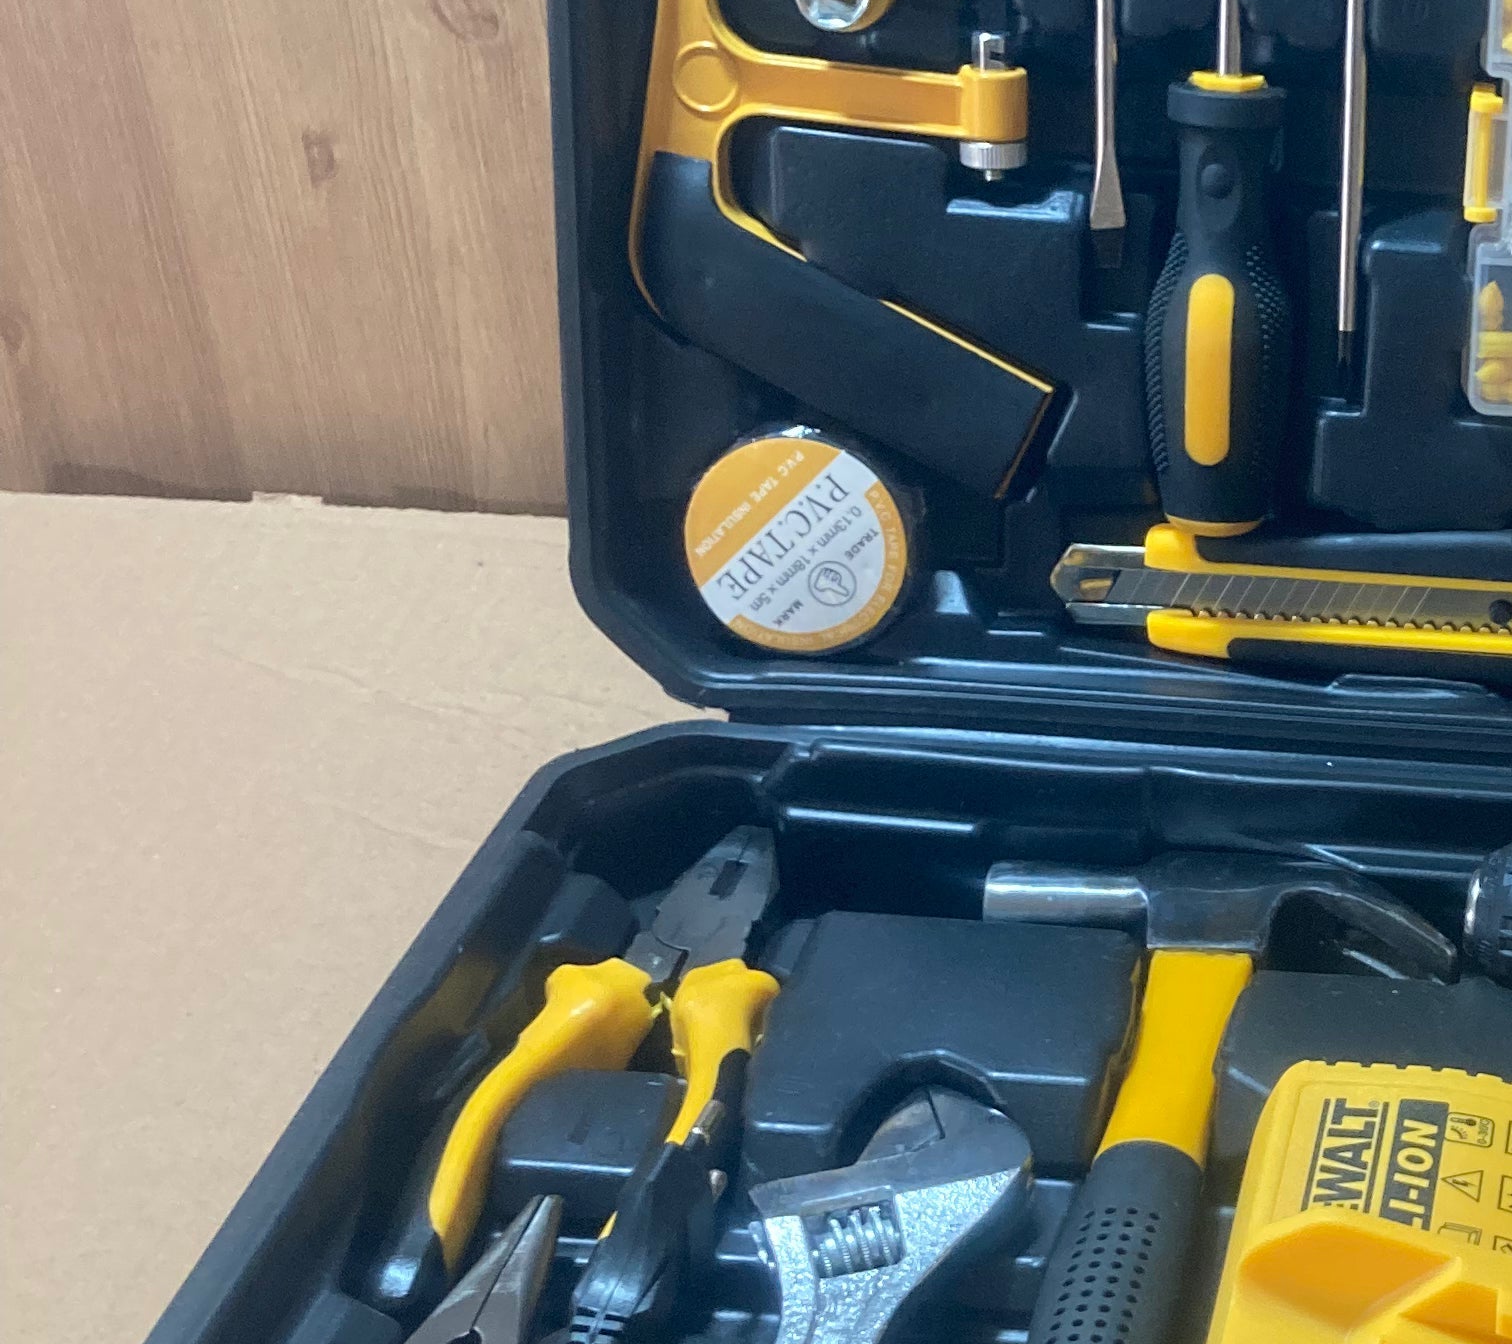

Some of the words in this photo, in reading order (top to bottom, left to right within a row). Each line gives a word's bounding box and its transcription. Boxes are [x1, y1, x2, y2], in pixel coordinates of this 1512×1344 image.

[749, 476, 779, 502] TAPE
[813, 506, 862, 548] 0.13mm
[844, 528, 879, 560] TRADE
[751, 591, 772, 612] 5m
[772, 599, 804, 627] MARK
